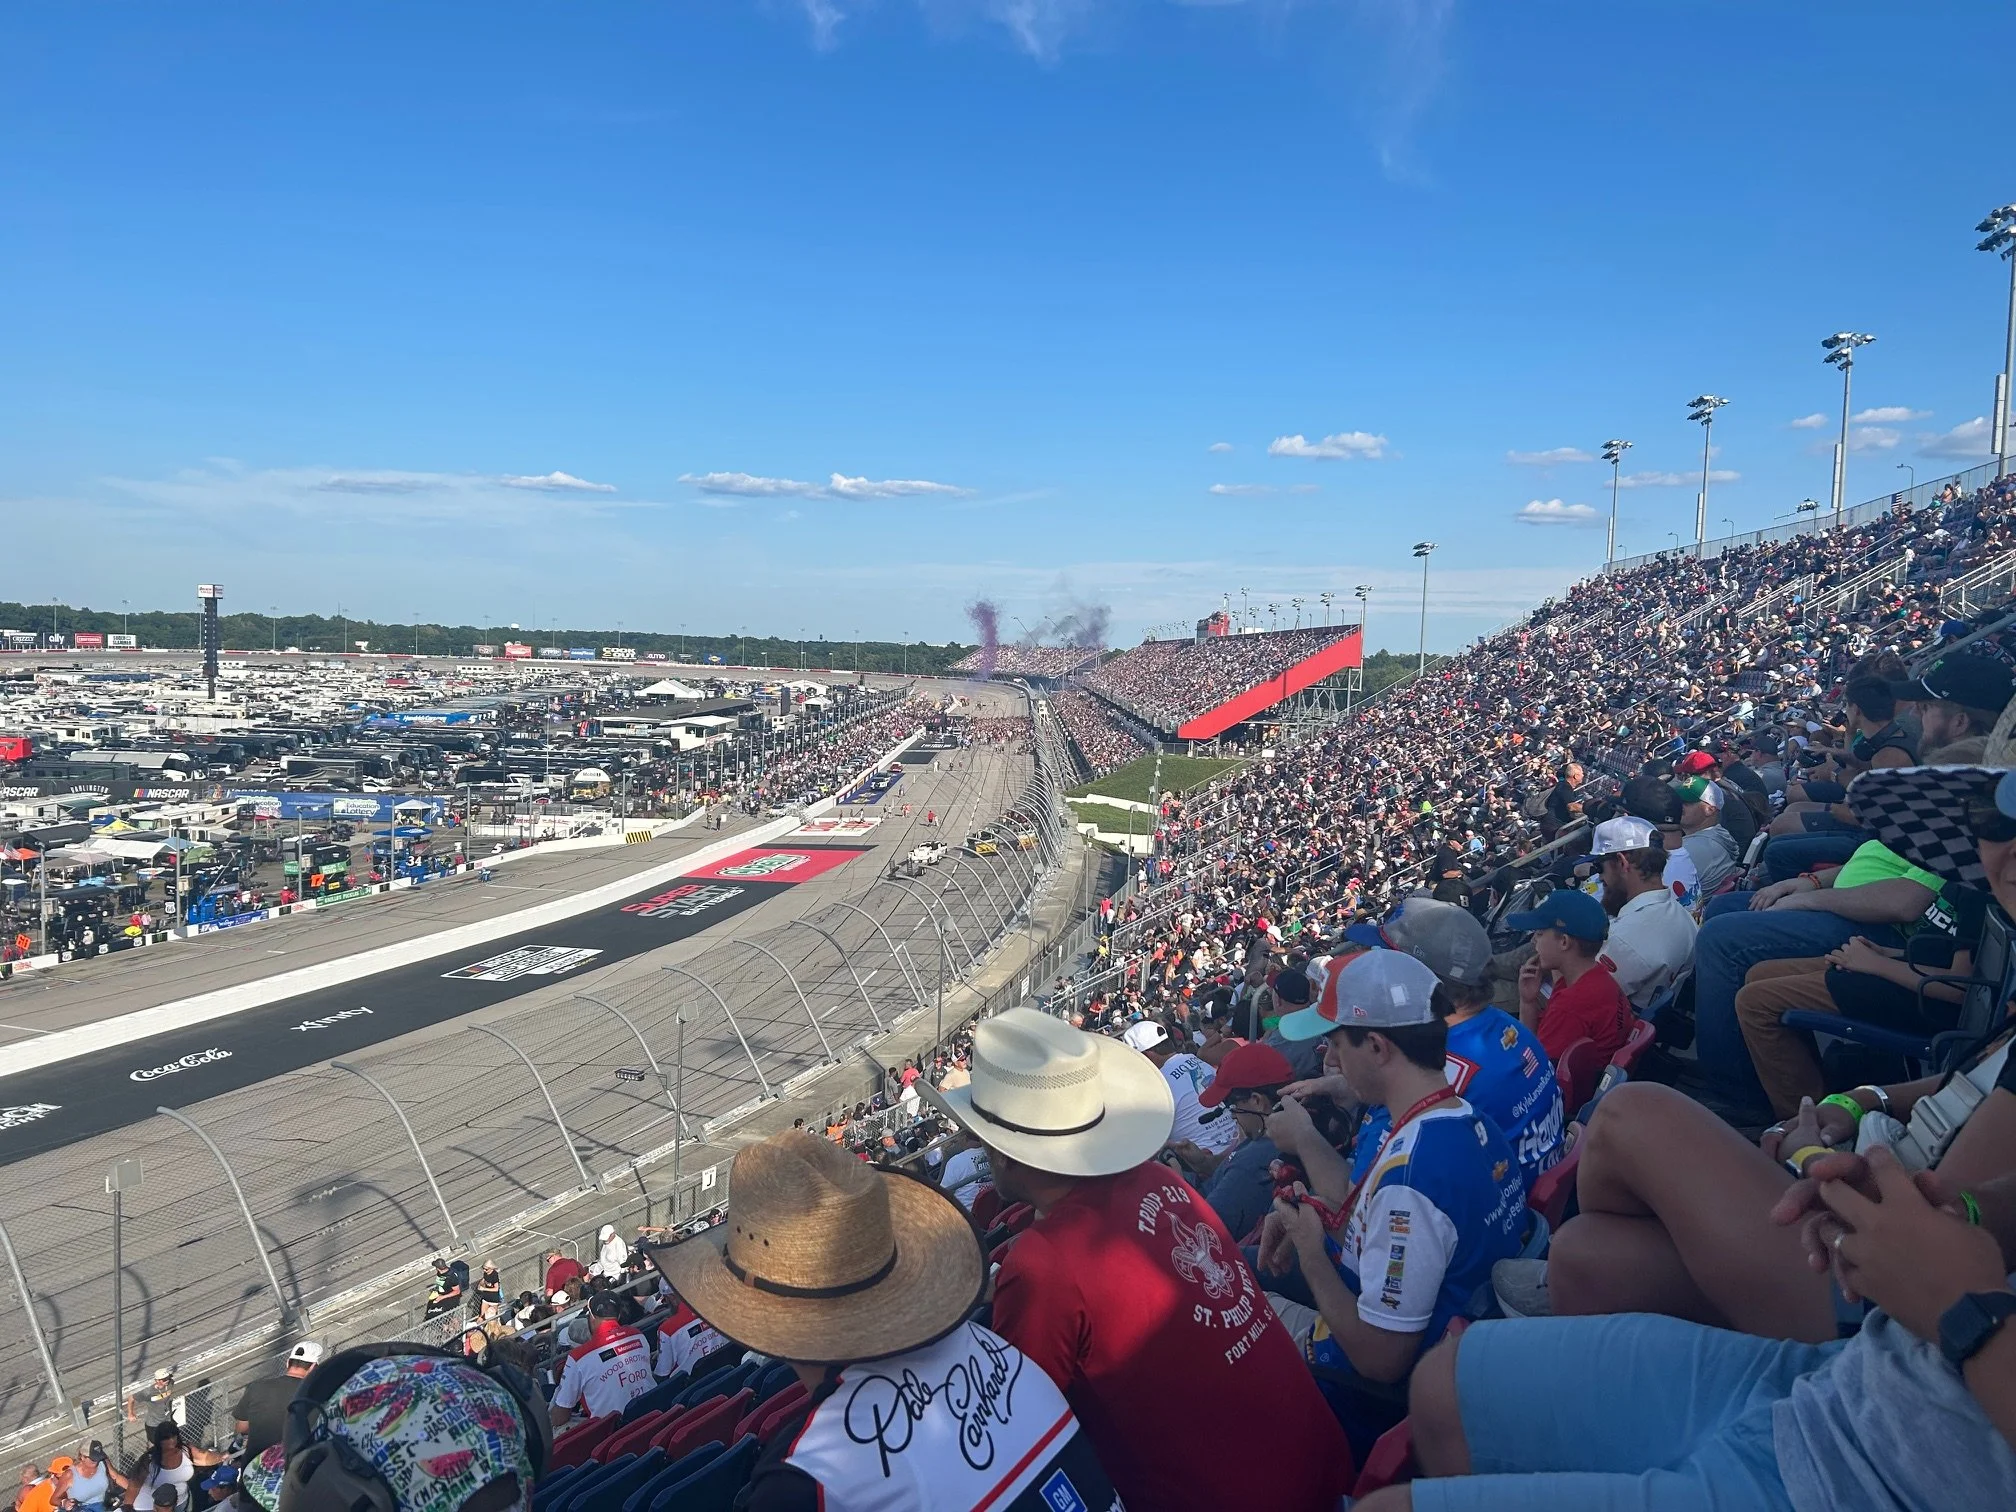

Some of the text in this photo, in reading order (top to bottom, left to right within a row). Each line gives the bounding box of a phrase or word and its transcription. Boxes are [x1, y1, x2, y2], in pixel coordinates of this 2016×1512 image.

[48, 633, 65, 645] ally
[147, 788, 190, 798] NASCAR
[491, 843, 504, 854] 5
[620, 884, 706, 913] SUPER
[637, 885, 728, 919] START
[290, 1006, 374, 1032] xfinity
[129, 1047, 233, 1082] Coca-Cola
[706, 1174, 713, 1187] J
[1138, 1185, 1191, 1236] TROOP 219
[1193, 1304, 1217, 1329] ST.
[1220, 1295, 1254, 1329] PHILIP
[1224, 1335, 1251, 1365] FORT
[600, 1361, 625, 1383] WOOD
[618, 1368, 648, 1388] FORD
[844, 1321, 1024, 1478] Dale Earnhardt
[1053, 1483, 1073, 1511] GM
